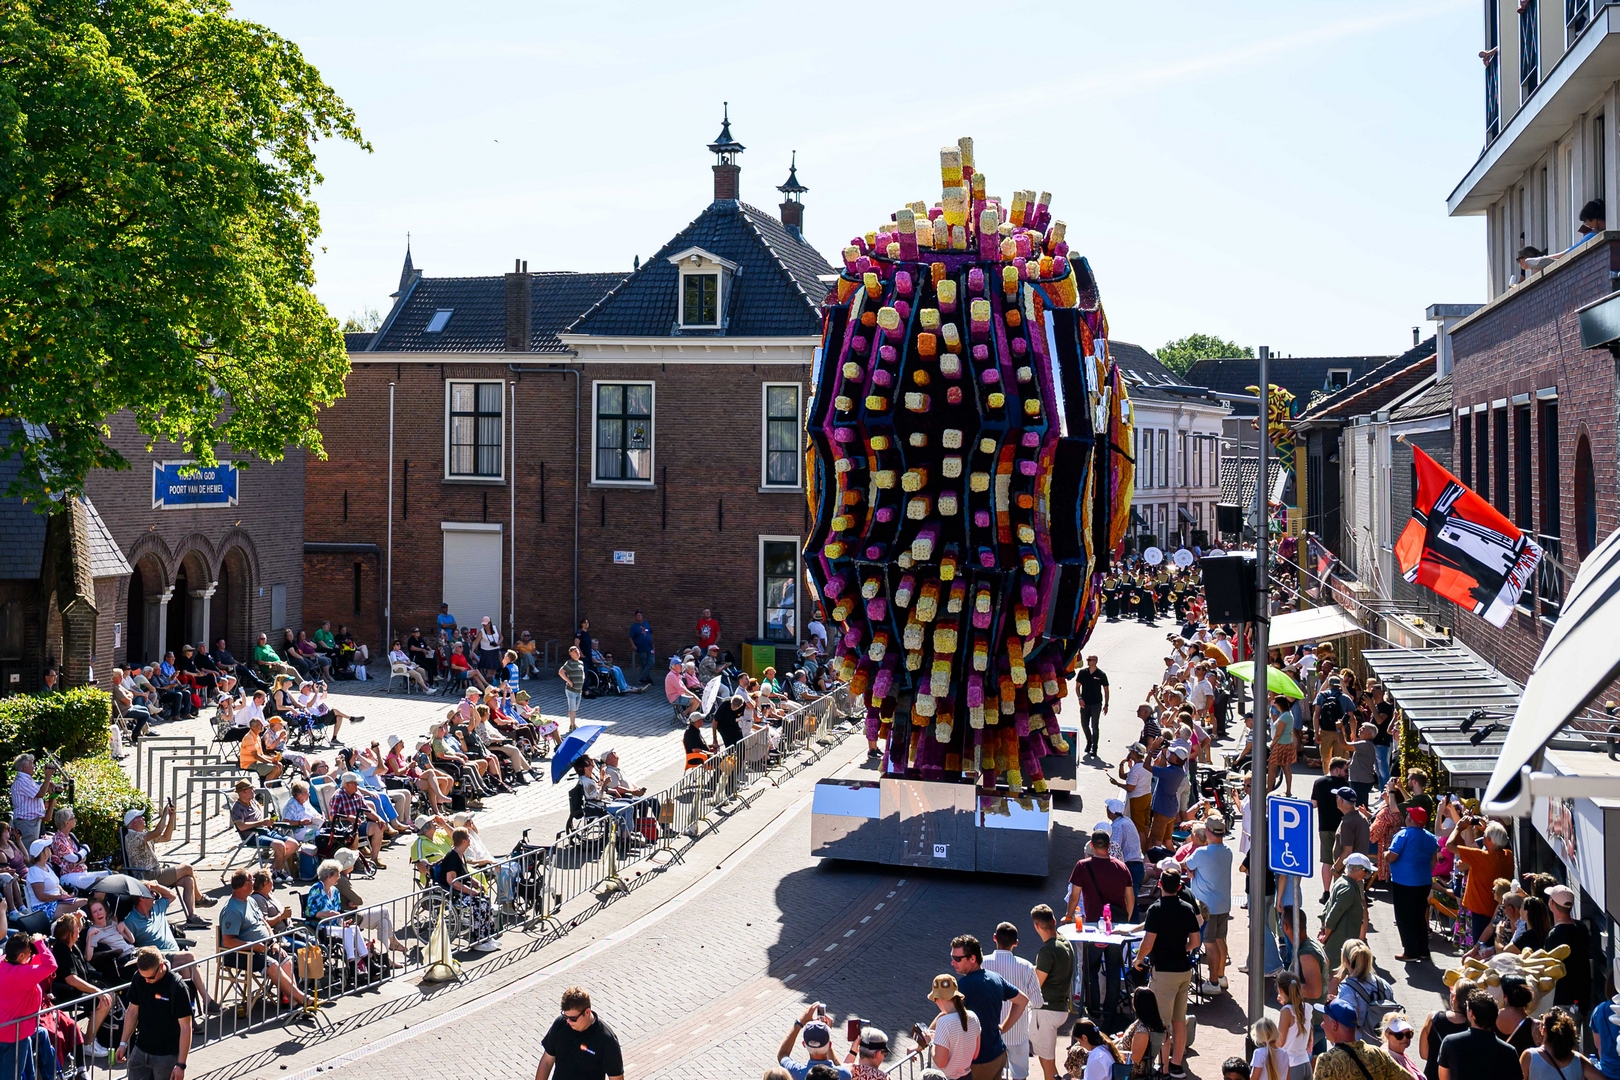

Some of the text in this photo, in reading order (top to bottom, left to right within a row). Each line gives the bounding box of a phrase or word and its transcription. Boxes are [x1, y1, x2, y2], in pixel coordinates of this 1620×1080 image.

[204, 472, 215, 480] GOD
[169, 484, 224, 495] POORT VAN DE HEMEL
[1279, 805, 1300, 840] P
